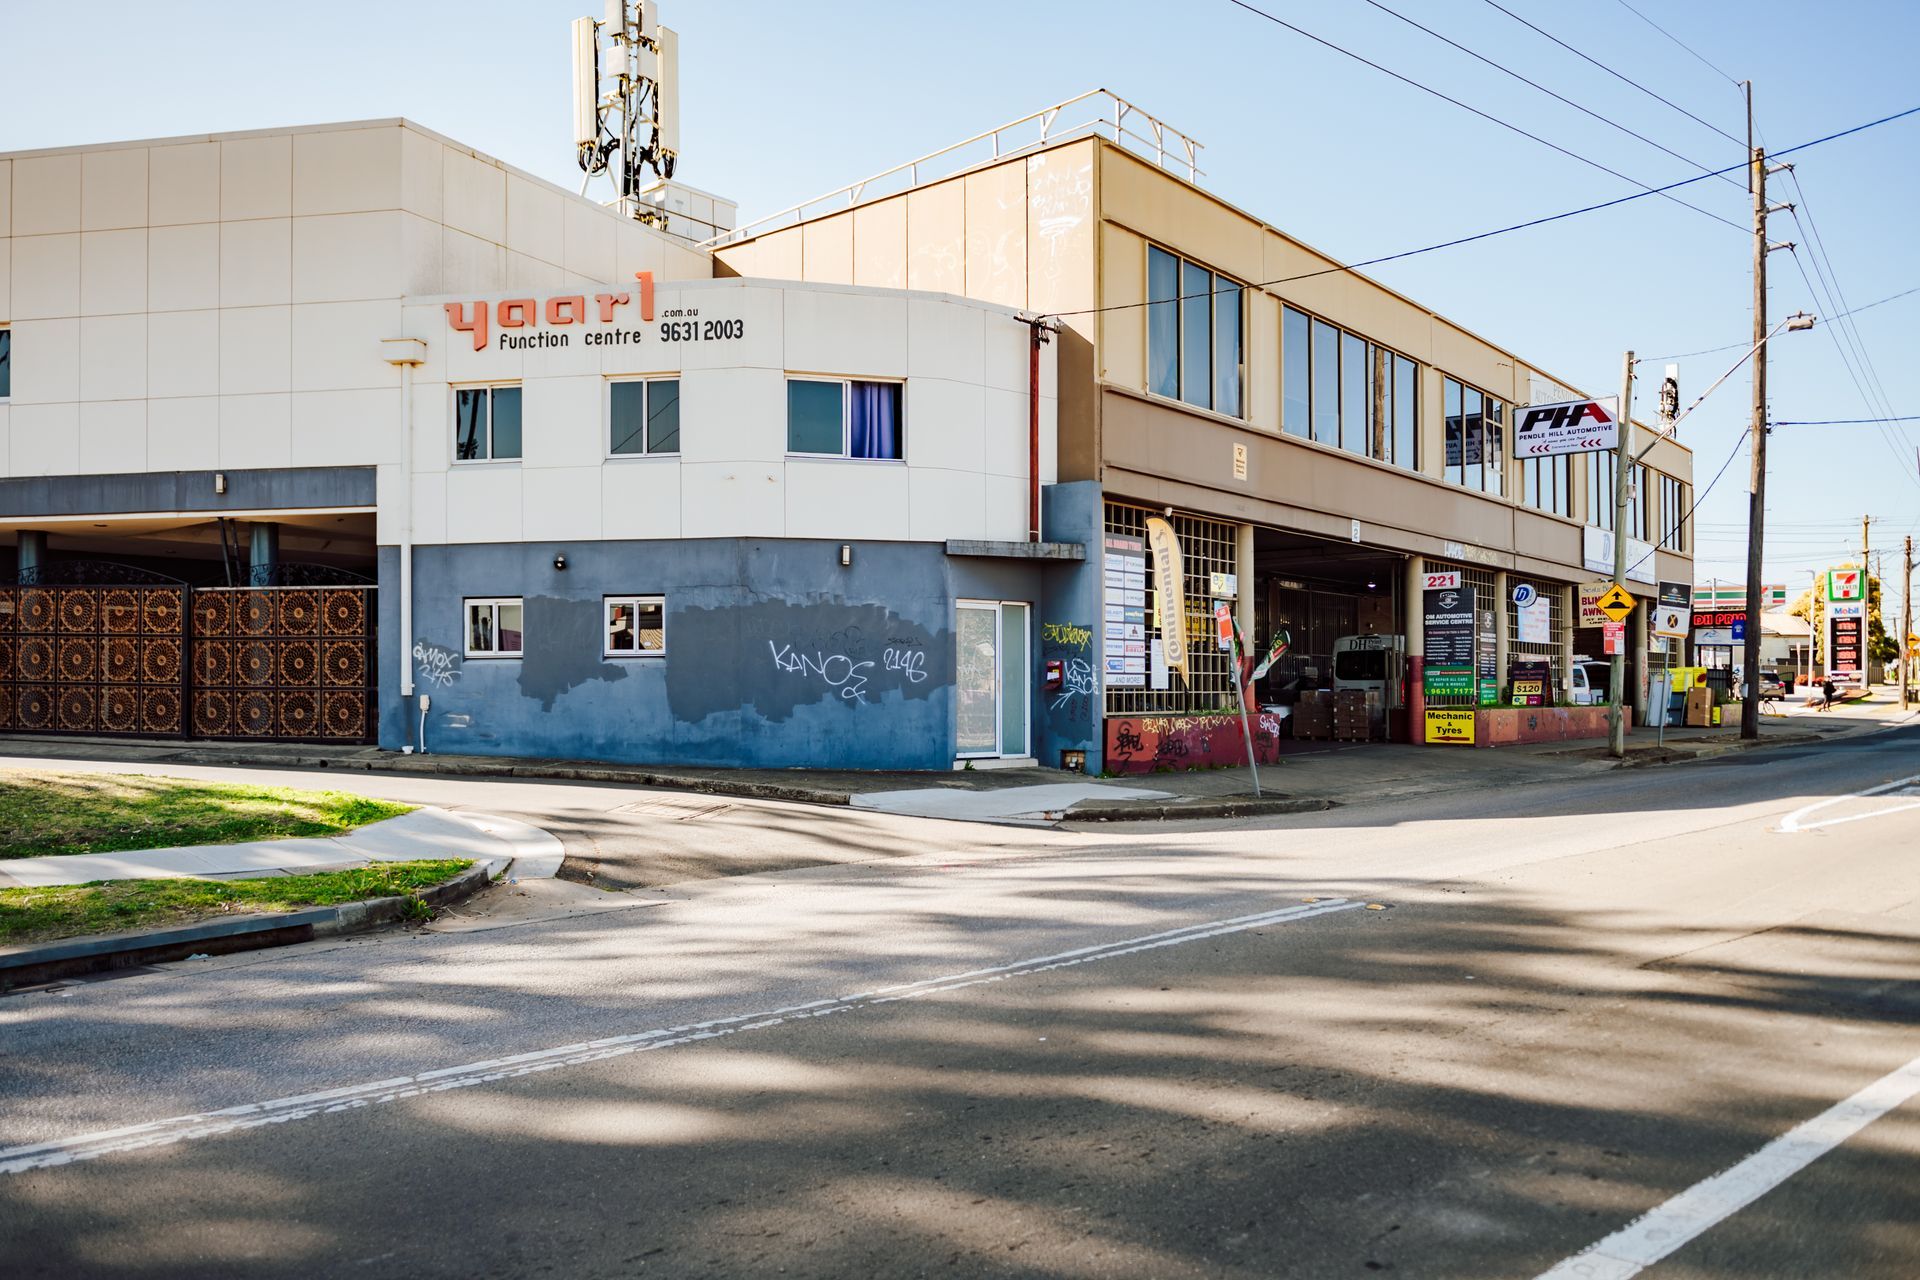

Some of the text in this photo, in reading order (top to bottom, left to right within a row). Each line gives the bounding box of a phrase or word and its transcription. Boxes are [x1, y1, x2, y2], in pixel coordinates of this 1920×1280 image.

[660, 319, 744, 343] 9631 2003
[584, 328, 641, 346] centre
[1519, 402, 1612, 433] PHA
[1519, 433, 1545, 441] PENDLE
[1567, 425, 1613, 435] AUTOMOTIVE
[1427, 575, 1455, 588] 221
[1582, 596, 1603, 606] BLIN
[1583, 607, 1605, 616] AWN
[1834, 607, 1859, 615] Mobil
[1517, 685, 1540, 693] $120
[1427, 712, 1473, 720] Mechanic
[1436, 726, 1462, 735] Tyres
